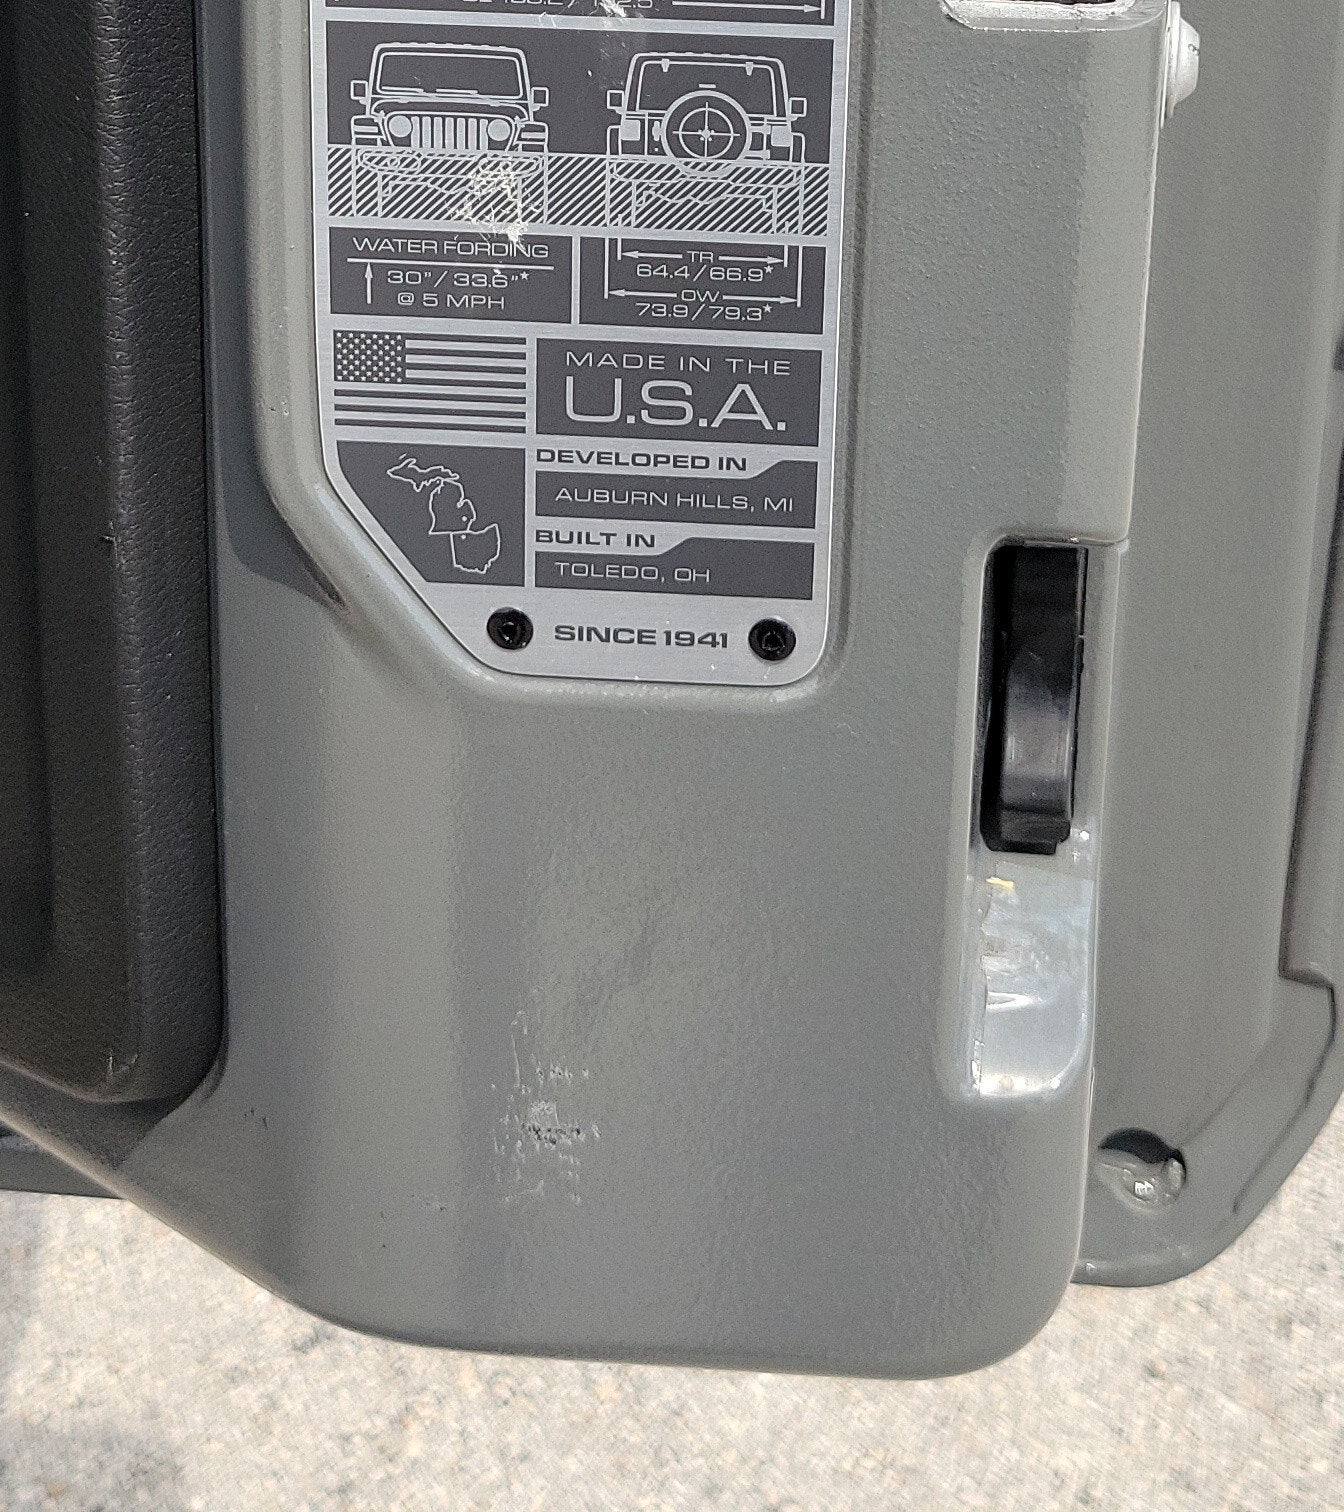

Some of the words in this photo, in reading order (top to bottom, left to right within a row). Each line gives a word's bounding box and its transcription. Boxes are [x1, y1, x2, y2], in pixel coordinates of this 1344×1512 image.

[353, 237, 438, 255] WATER
[444, 241, 549, 258] FORDING
[687, 250, 714, 263] TR
[397, 292, 415, 306] @
[422, 292, 439, 307] 5
[446, 294, 505, 310] MPH
[681, 289, 720, 303] OW
[566, 351, 666, 371] MADE
[679, 356, 712, 373] IN
[725, 358, 792, 376] THE
[565, 375, 787, 431] U.S.A.
[536, 448, 711, 470] DEVELOPED
[717, 456, 747, 471] IN
[555, 488, 668, 507] AUBURN
[676, 491, 755, 513] HILLS,
[764, 497, 794, 512] MI
[535, 529, 618, 546] BUILT
[626, 533, 656, 548] IN
[555, 561, 666, 583] TOLEDO,
[674, 567, 710, 583] OH
[554, 624, 656, 645] SINCE
[663, 630, 728, 649] 1941
